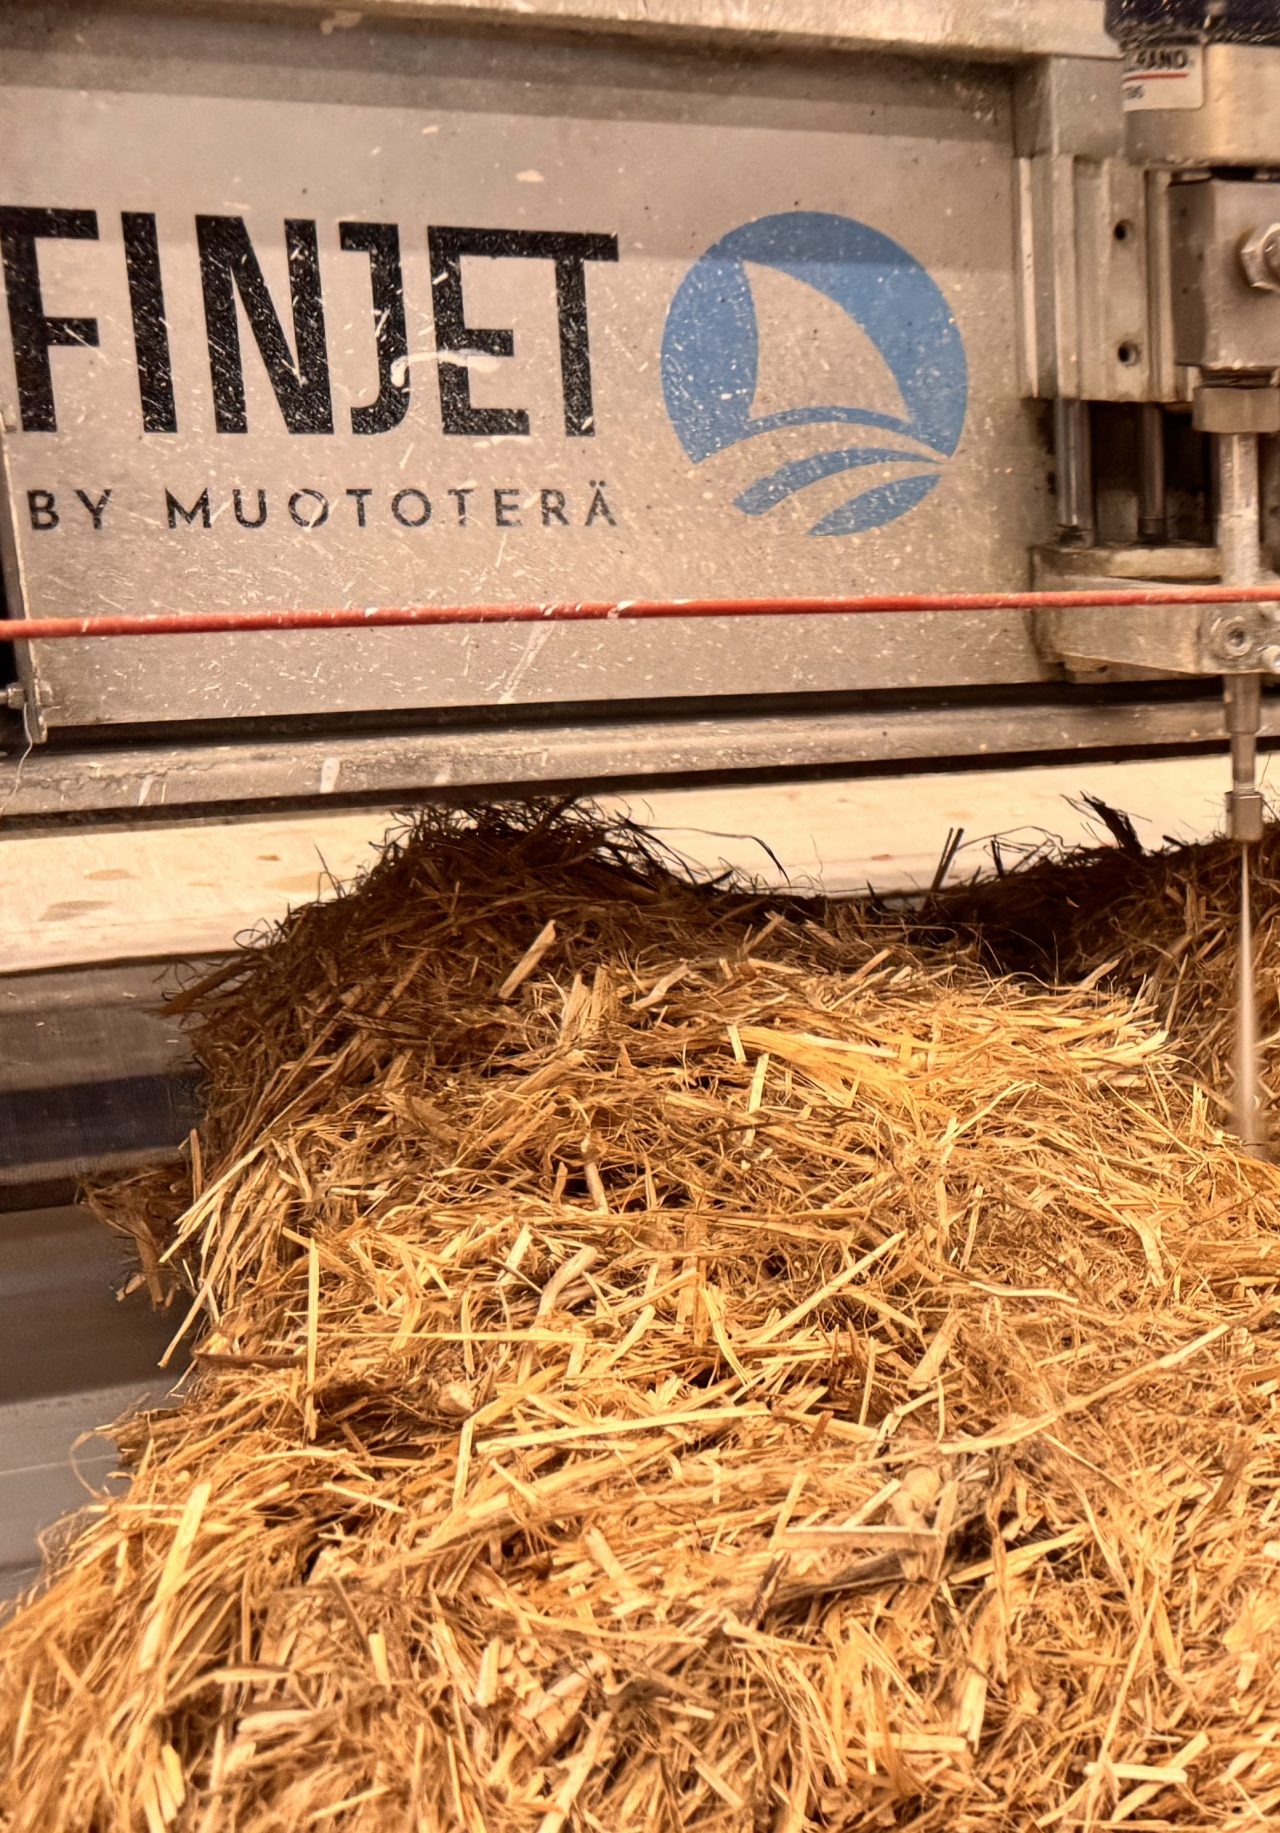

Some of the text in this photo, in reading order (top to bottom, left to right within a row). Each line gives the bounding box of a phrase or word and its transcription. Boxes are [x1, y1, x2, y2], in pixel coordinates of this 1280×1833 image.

[0, 205, 620, 438] FINJET
[27, 480, 620, 532] BY MUOTOTERÄ
